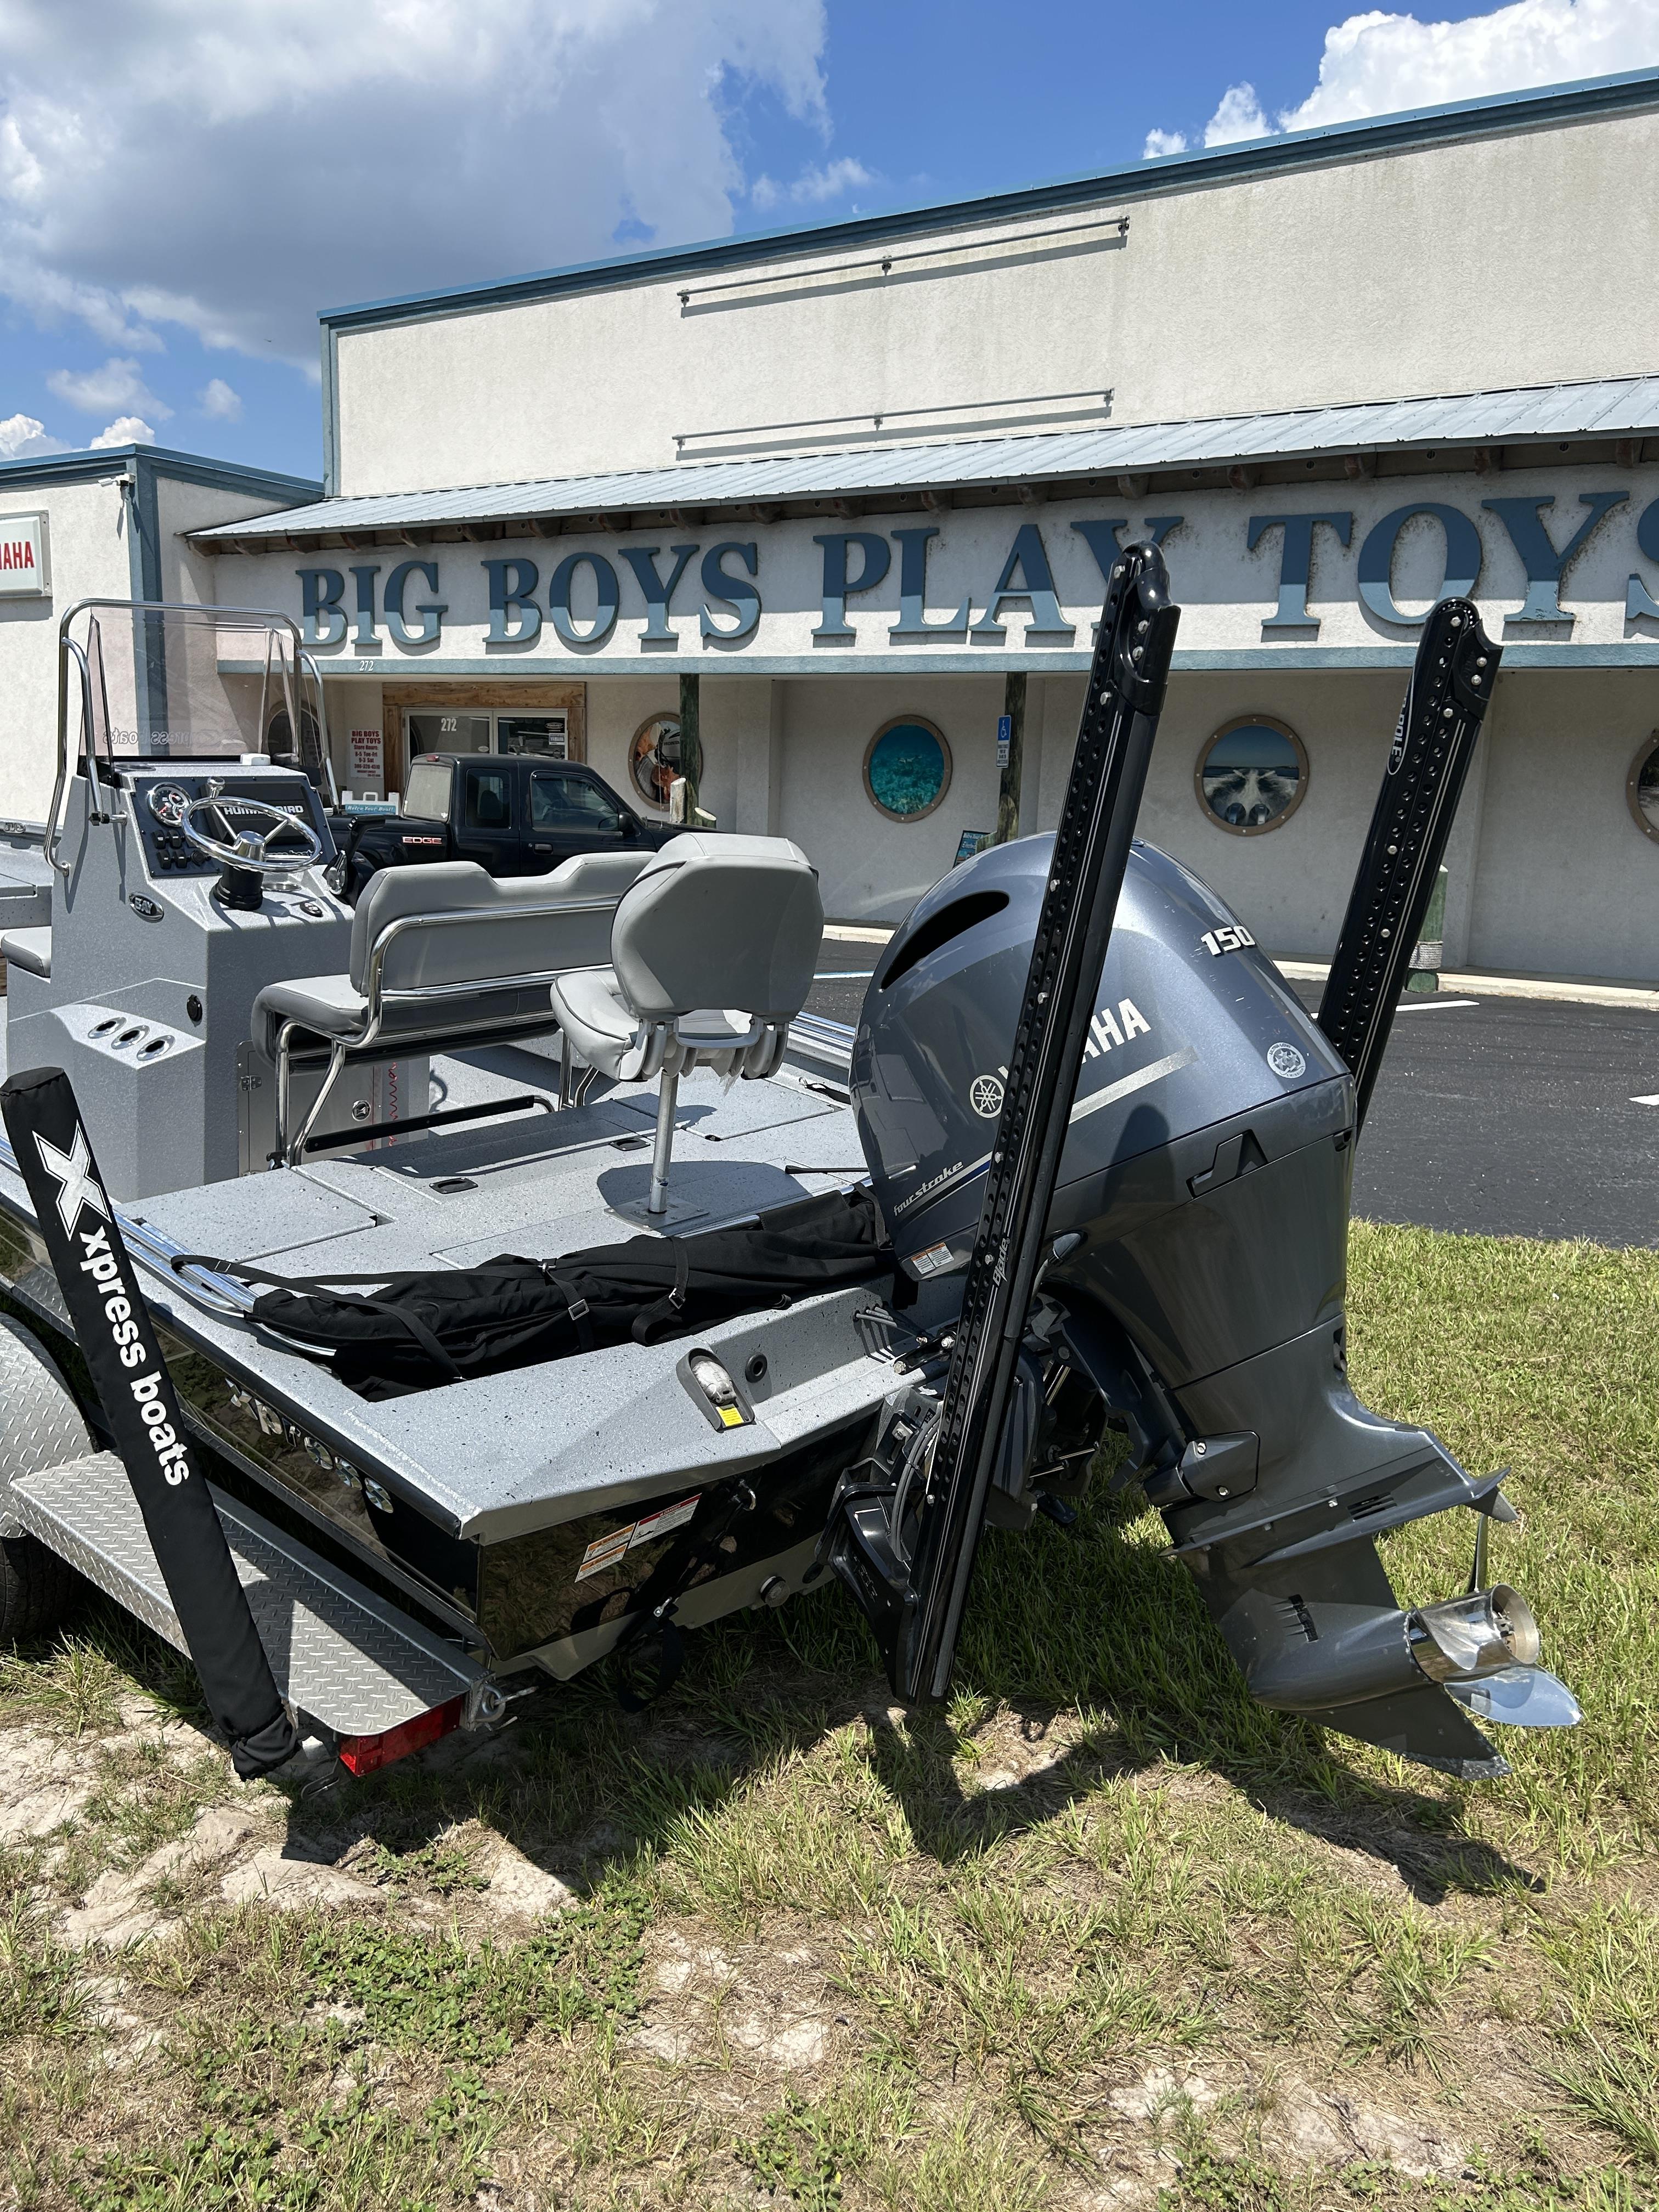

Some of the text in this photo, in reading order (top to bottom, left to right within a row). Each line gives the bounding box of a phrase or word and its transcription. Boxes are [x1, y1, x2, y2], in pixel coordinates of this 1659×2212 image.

[0, 541, 35, 569] AHA
[295, 561, 448, 645] BIG
[481, 542, 762, 643] BOYS
[359, 661, 374, 672] 272
[441, 718, 456, 731] 272
[402, 836, 442, 844] EDGE
[1200, 925, 1256, 956] 150
[80, 1226, 147, 1368] xpress
[130, 1371, 190, 1486] boats
